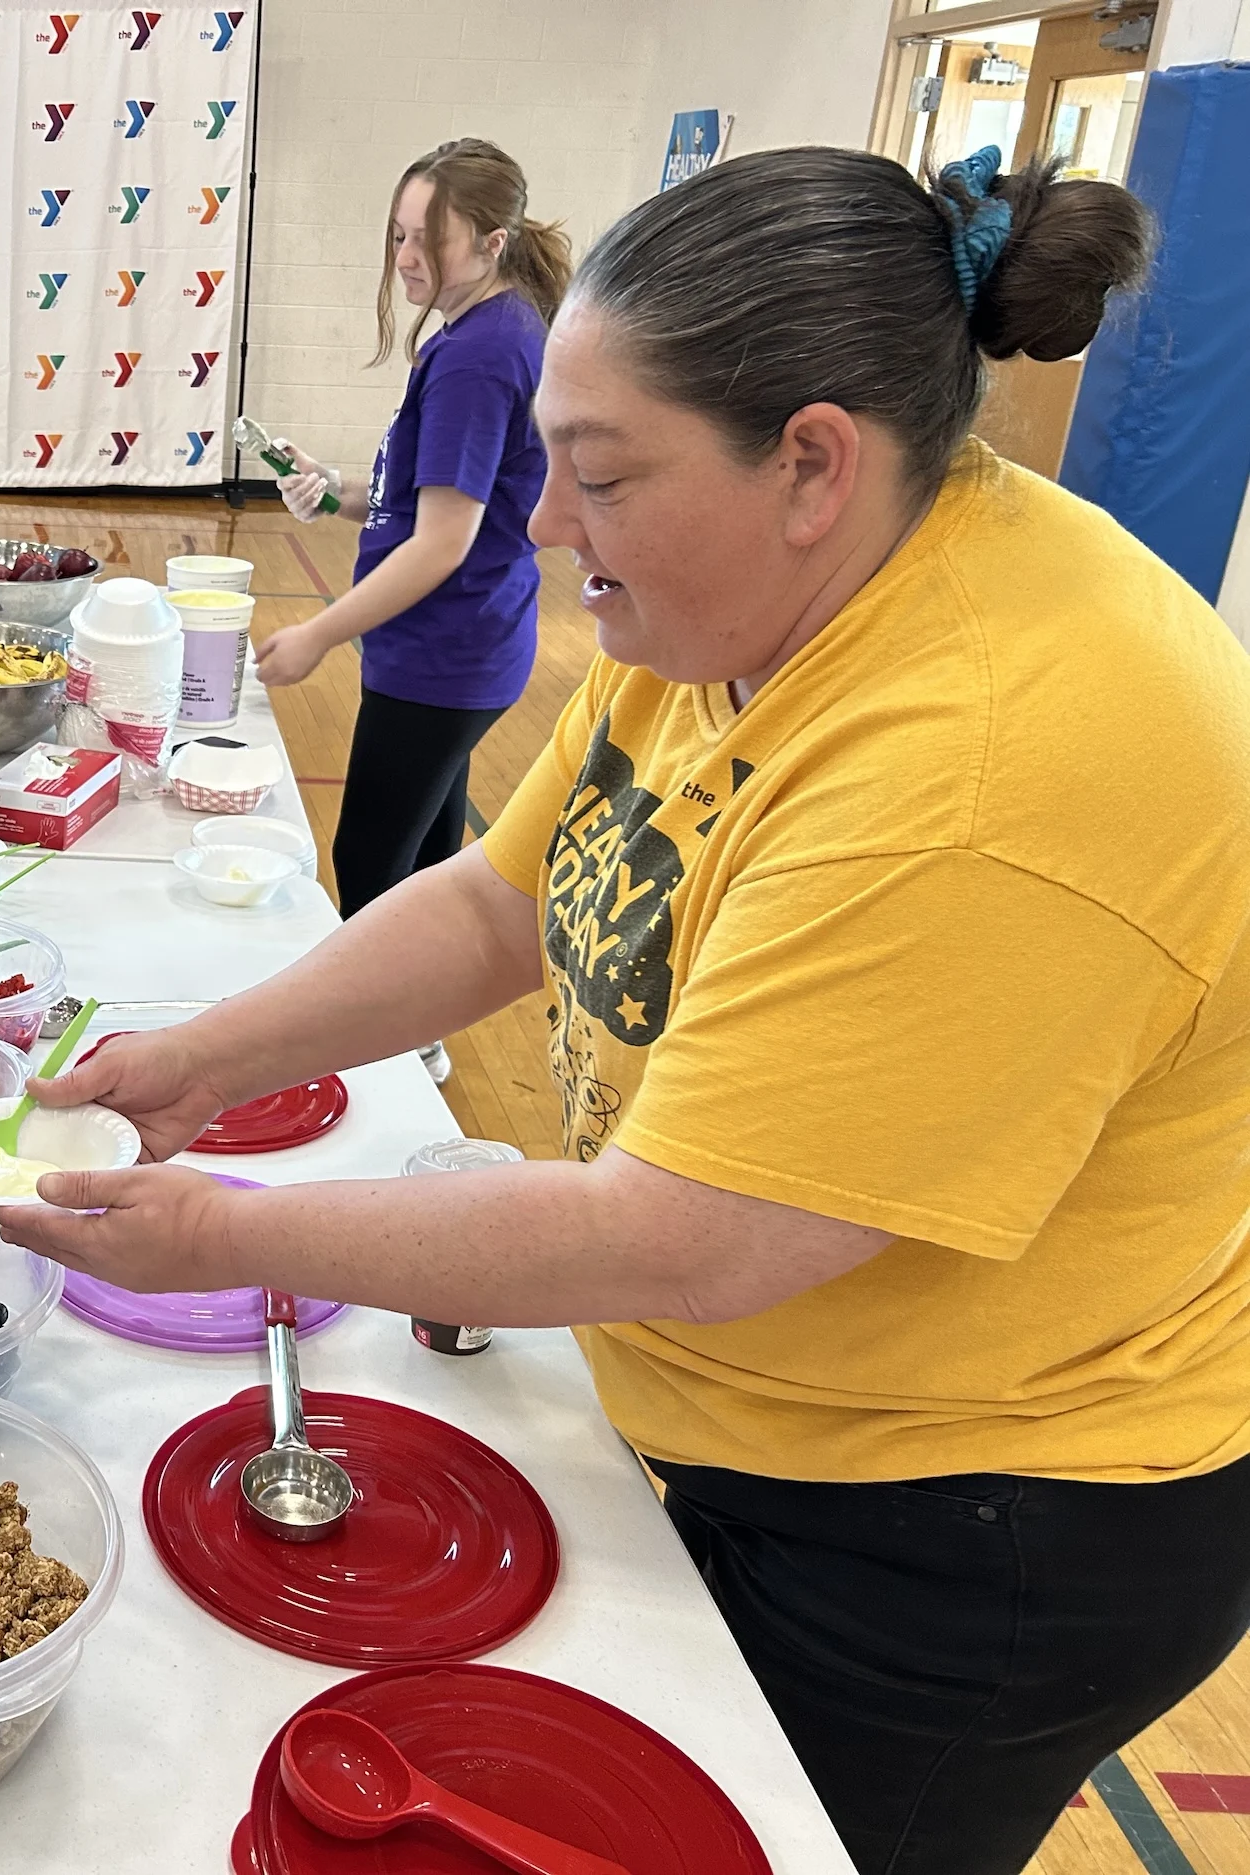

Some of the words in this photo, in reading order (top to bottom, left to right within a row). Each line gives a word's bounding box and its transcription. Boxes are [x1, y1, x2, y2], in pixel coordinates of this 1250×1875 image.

[36, 33, 50, 42] the
[119, 31, 132, 39] the
[200, 31, 214, 39] the
[32, 121, 46, 130] the
[114, 119, 126, 128] the
[194, 120, 207, 128] the
[666, 153, 711, 181] HEALTHY
[29, 207, 42, 215] the
[108, 205, 121, 213] the
[188, 205, 201, 213] the
[27, 290, 40, 298] the
[24, 371, 38, 379] the
[178, 369, 192, 377] the
[99, 448, 112, 456] the
[174, 448, 188, 456] the
[681, 781, 716, 807] the
